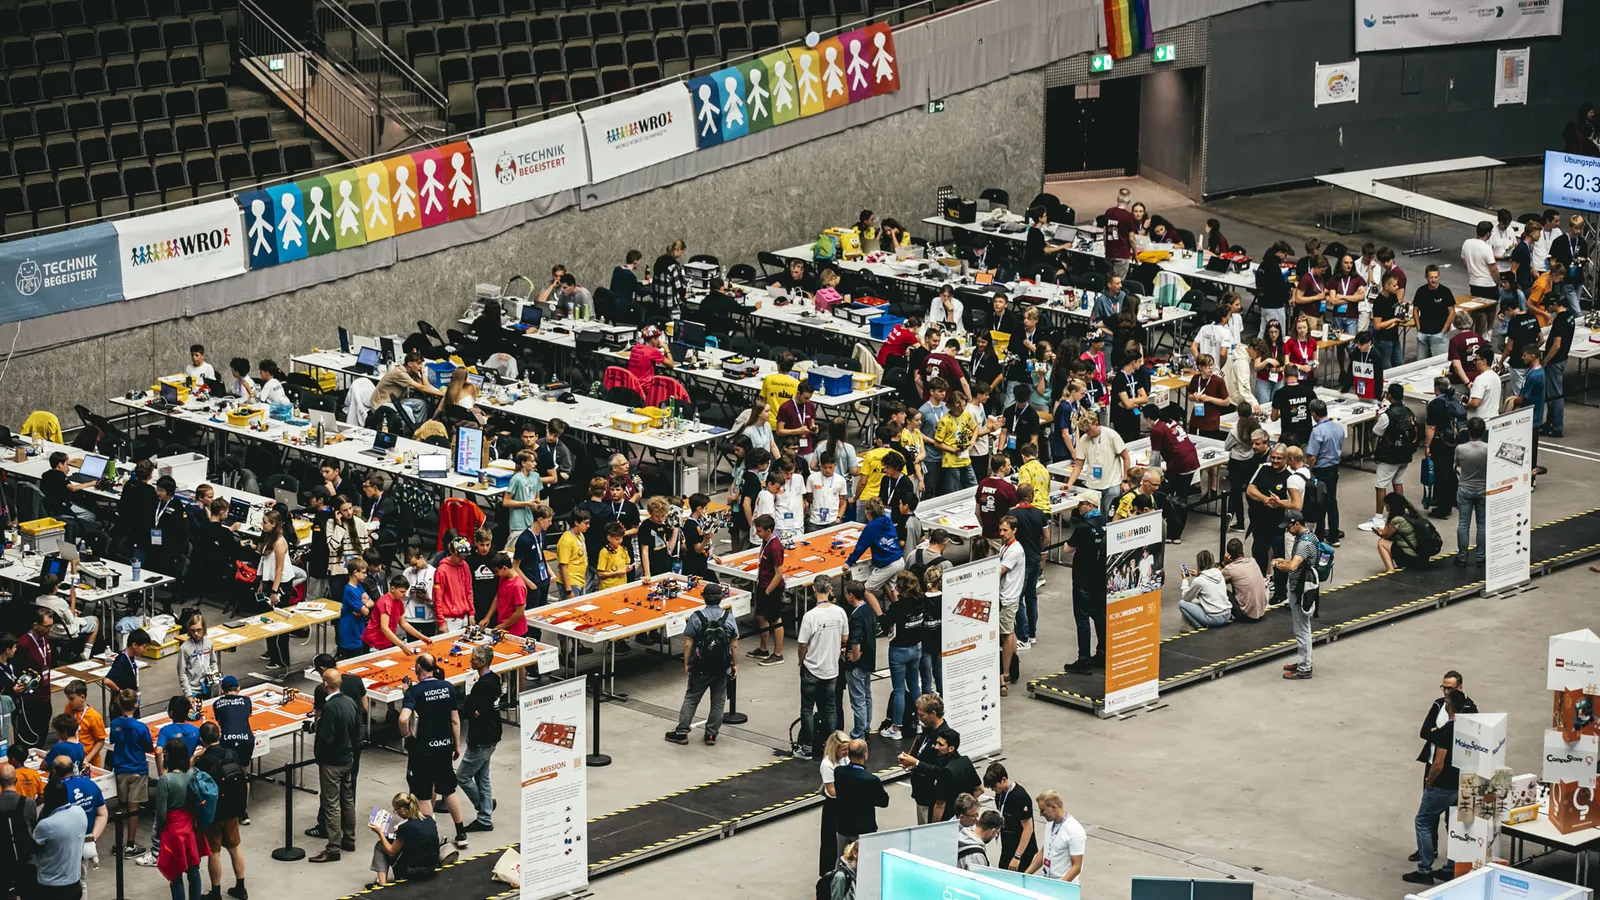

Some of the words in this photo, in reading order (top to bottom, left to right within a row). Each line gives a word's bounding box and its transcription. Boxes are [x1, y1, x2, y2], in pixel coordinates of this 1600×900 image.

[638, 112, 667, 133] WRO
[518, 144, 565, 166] TECHNIK
[519, 157, 566, 177] BEGEISTERT
[179, 229, 222, 256] WRO
[43, 253, 98, 276] TECHNIK
[44, 268, 98, 288] BEGEISTERT
[1289, 397, 1307, 405] TEAM
[1565, 660, 1594, 669] education
[223, 733, 249, 741] Leonid
[429, 738, 451, 747] COACH
[1546, 754, 1583, 763] CompuStore
